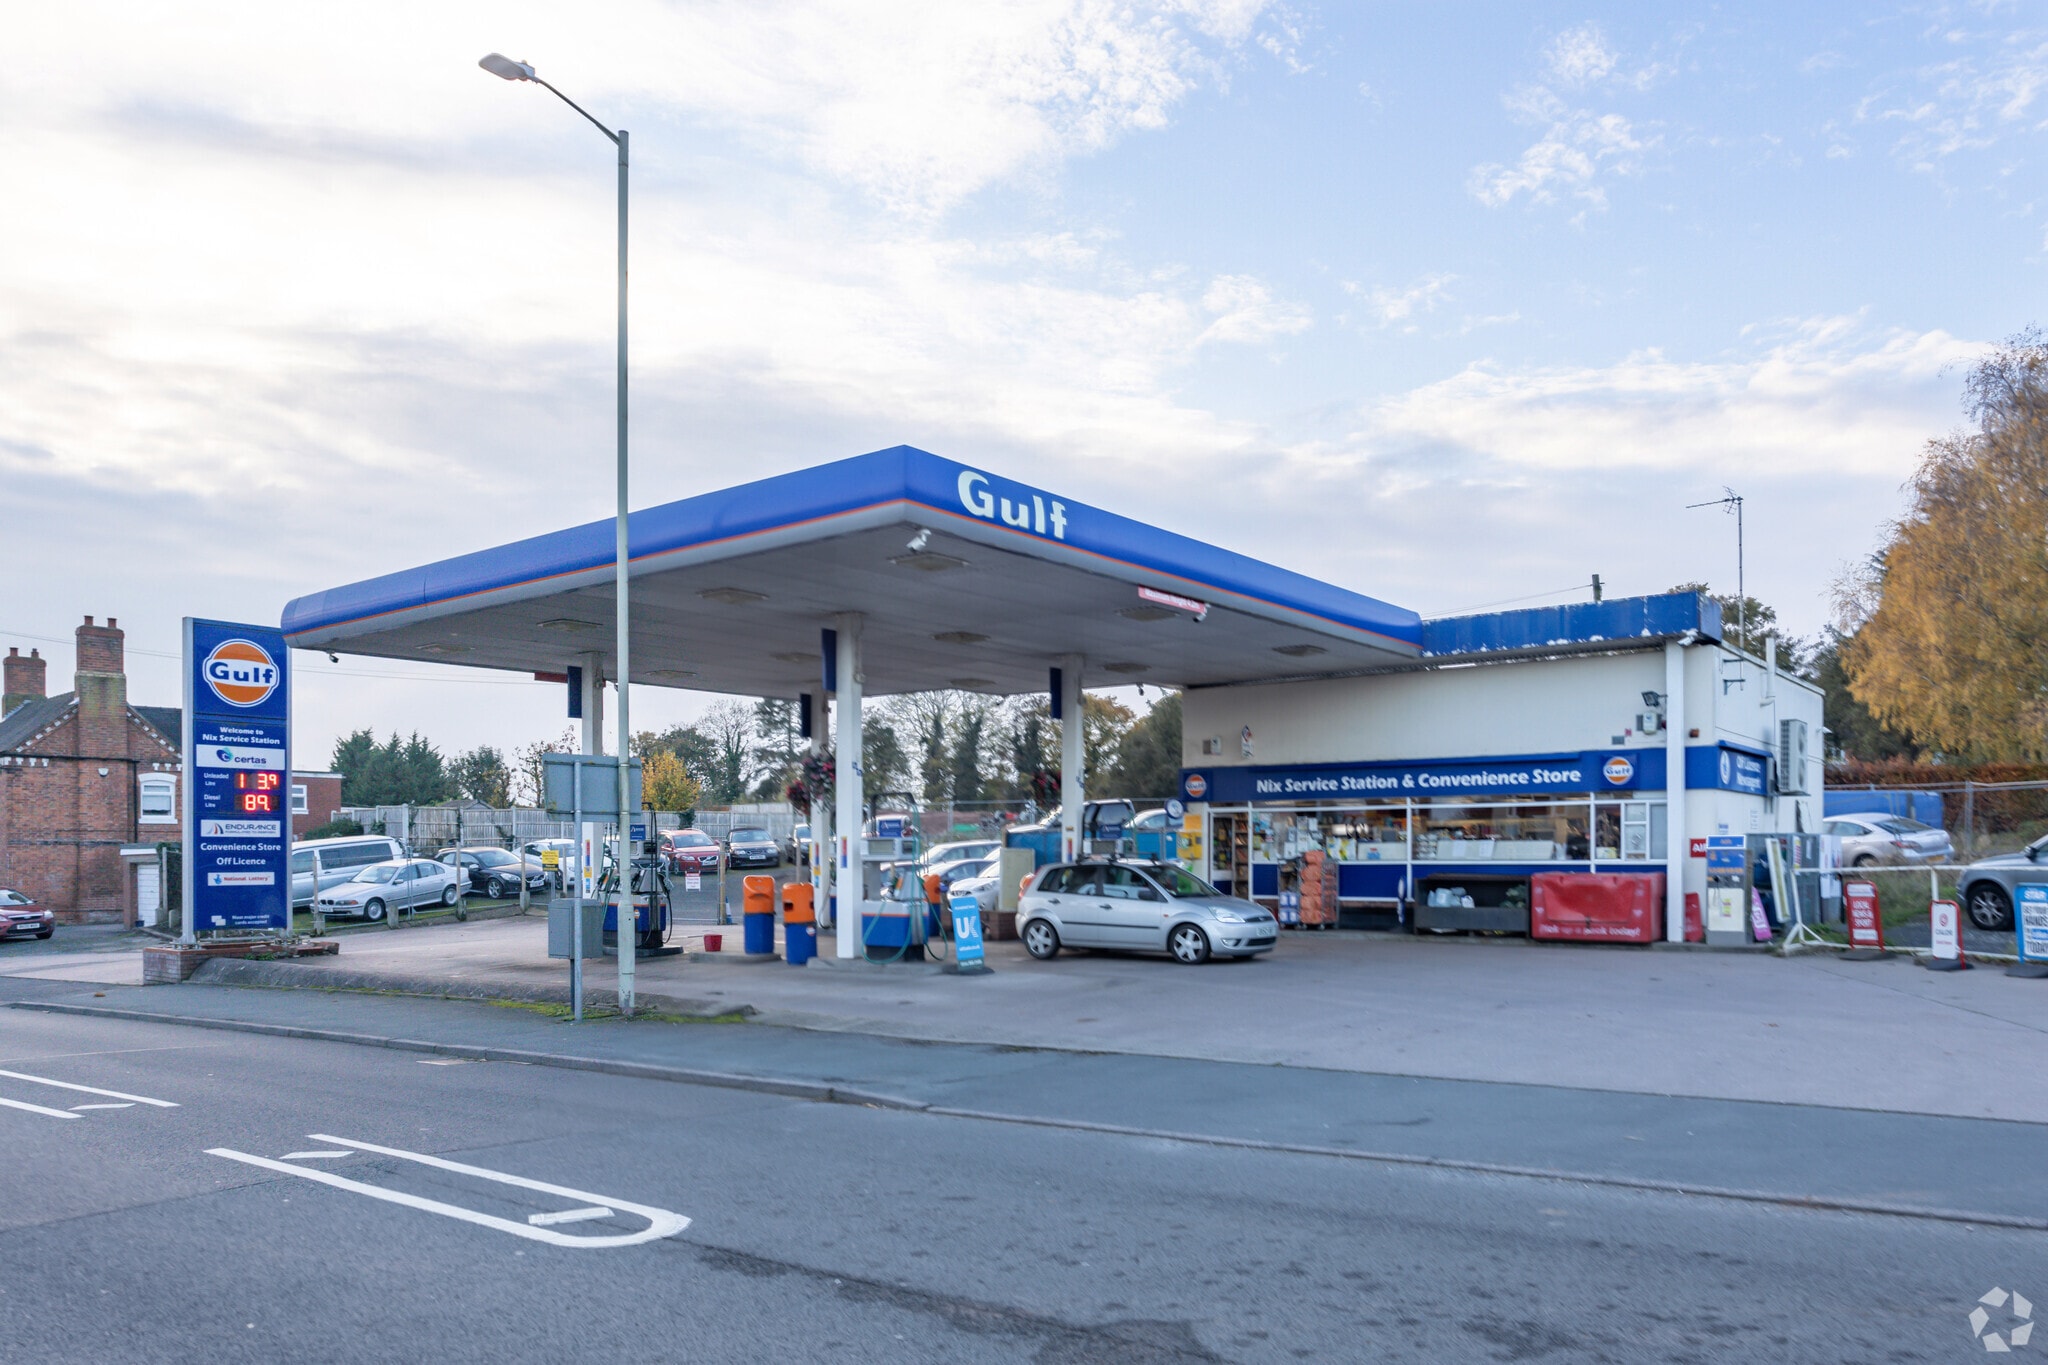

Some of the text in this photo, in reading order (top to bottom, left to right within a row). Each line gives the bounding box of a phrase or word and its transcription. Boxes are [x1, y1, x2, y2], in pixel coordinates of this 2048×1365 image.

[958, 470, 1067, 540] Gulf
[209, 661, 274, 684] Gulf
[220, 726, 254, 735] Welcome
[220, 735, 249, 743] Service
[251, 736, 280, 744] Station
[234, 756, 267, 764] certas
[1256, 768, 1582, 793] Nix Service Station & Convenience Store
[200, 843, 281, 851] Convenience Store
[216, 857, 266, 865] Off Licence
